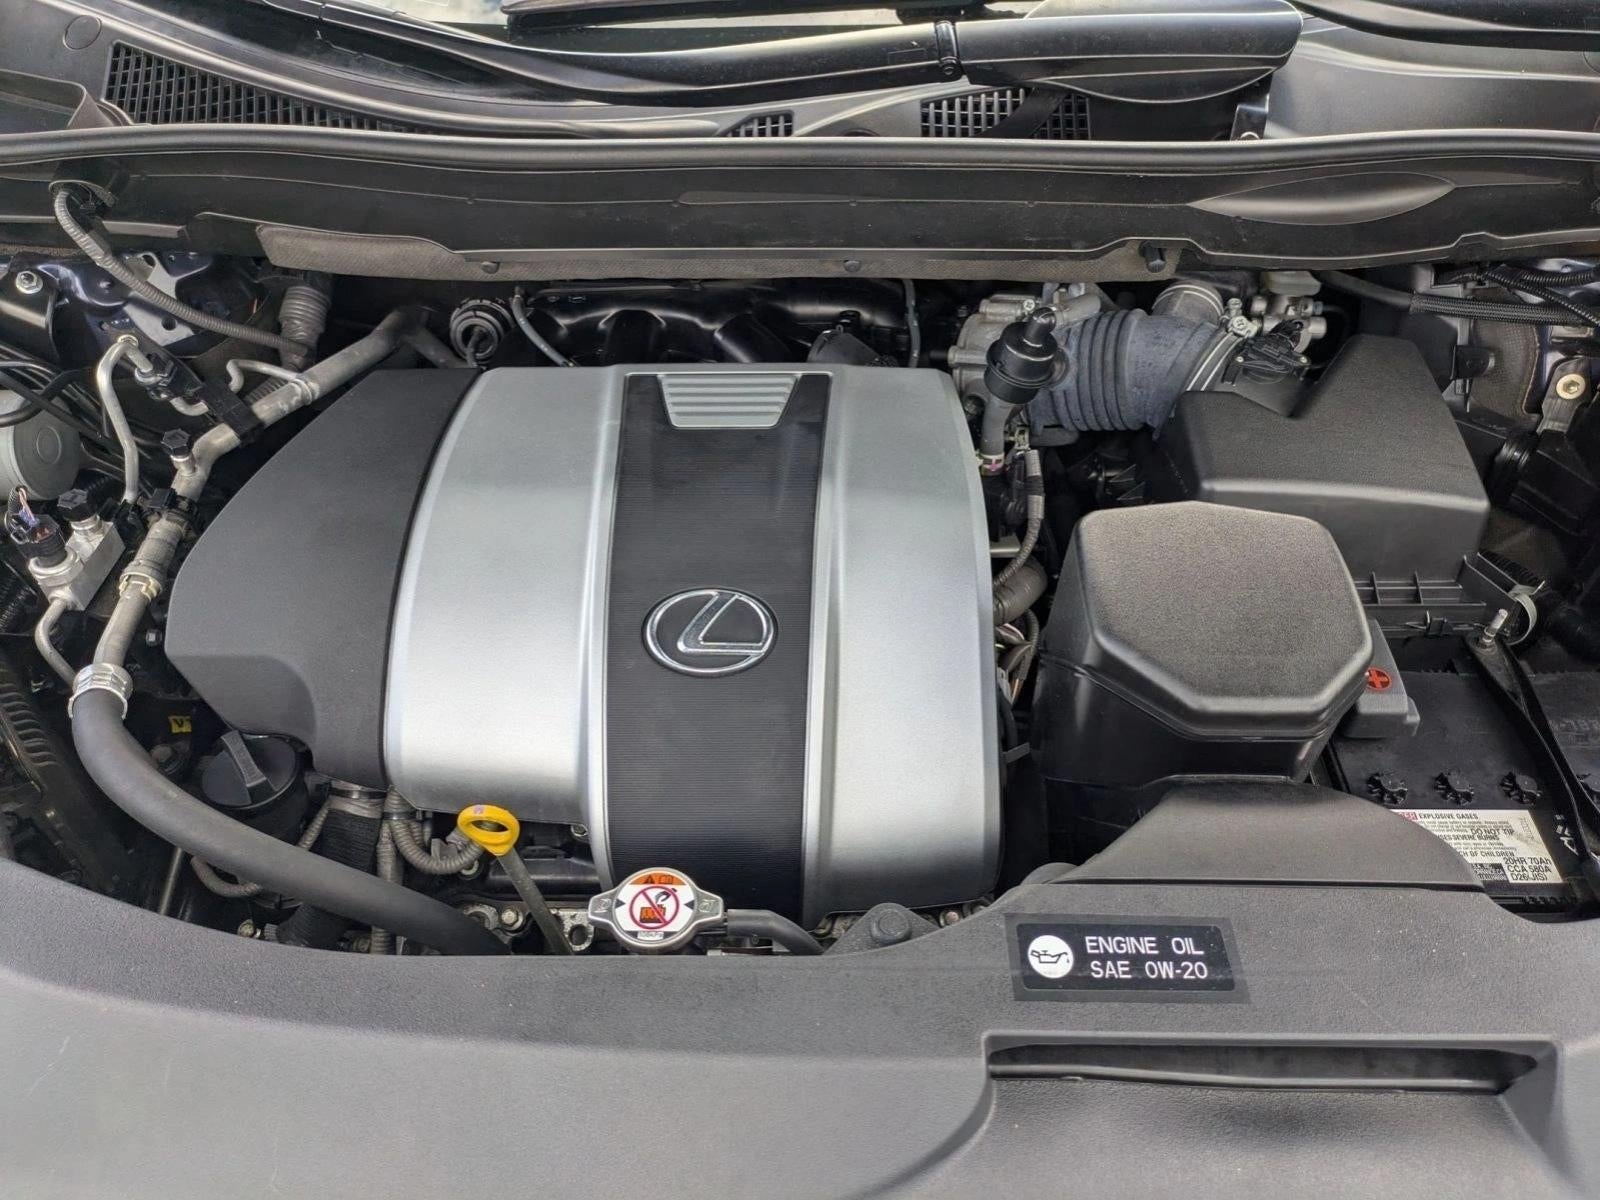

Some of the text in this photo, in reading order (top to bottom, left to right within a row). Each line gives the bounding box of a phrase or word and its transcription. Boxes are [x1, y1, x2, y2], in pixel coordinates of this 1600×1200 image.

[1503, 857, 1552, 865] 20HR 70Ah
[1507, 865, 1528, 873] CCA
[1528, 865, 1552, 873] 580A
[1511, 873, 1548, 881] D26(JIS)
[1085, 936, 1204, 955] ENGINE OIL
[1090, 961, 1208, 979] SAE 0W-20
